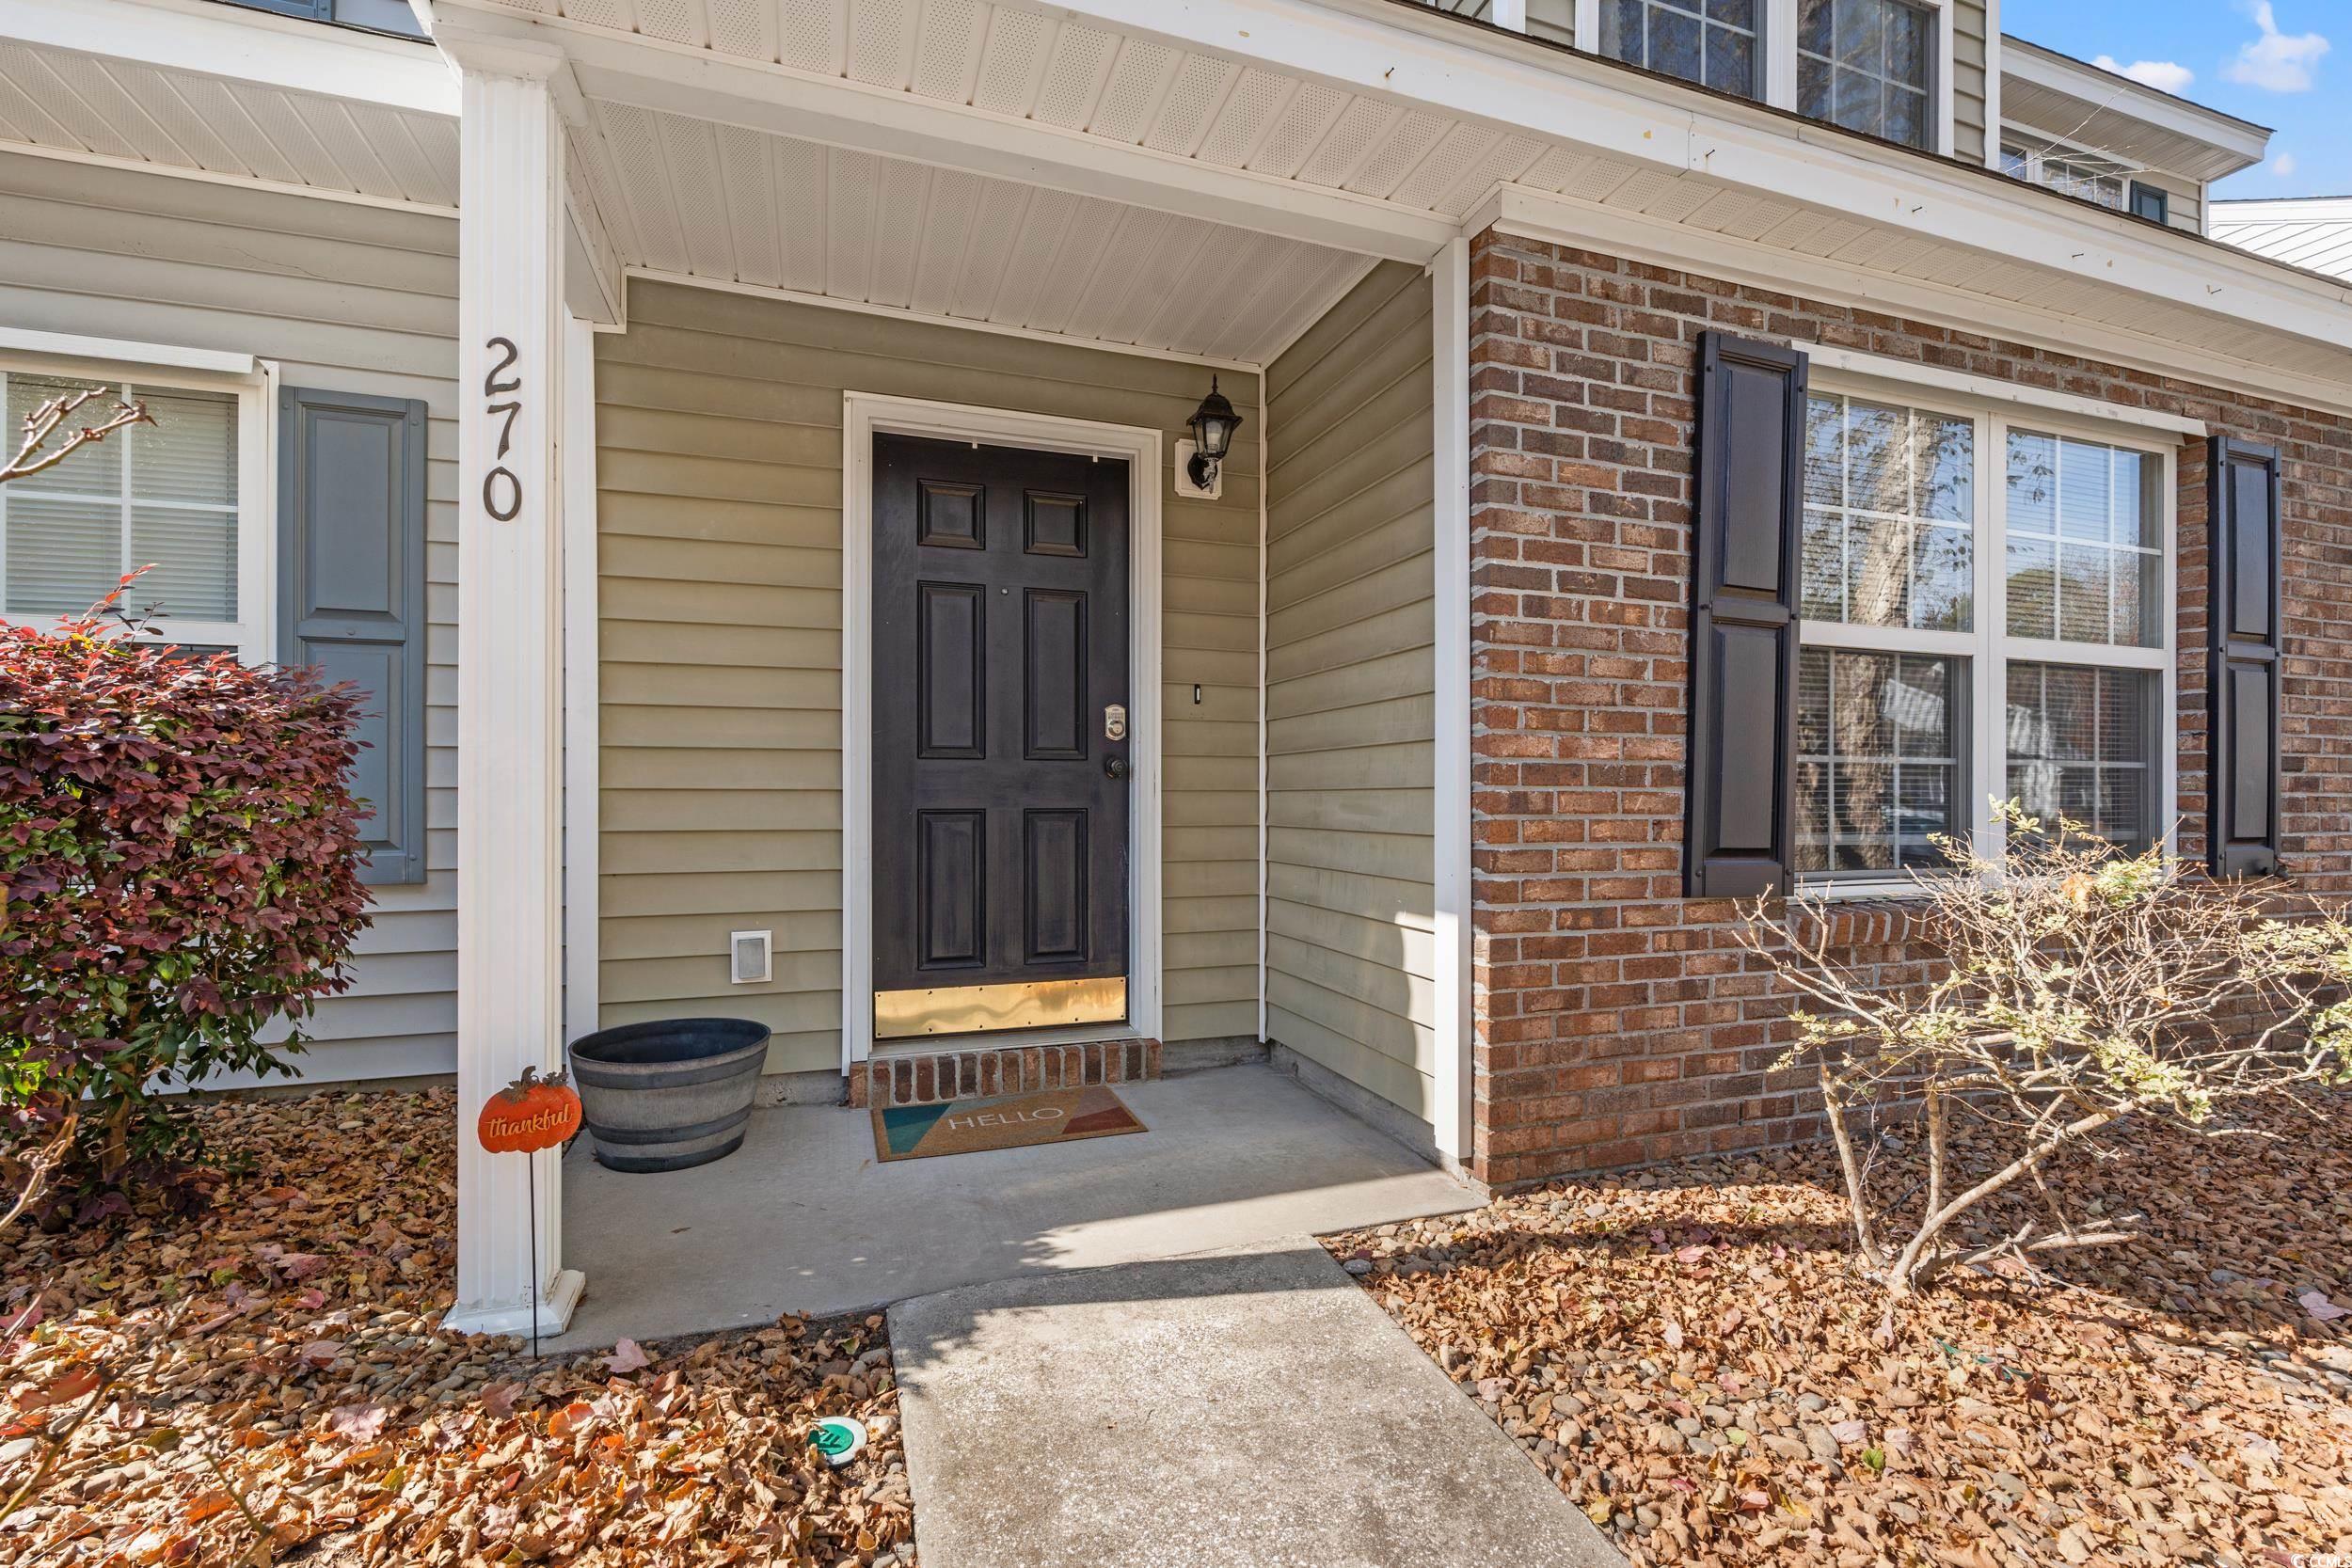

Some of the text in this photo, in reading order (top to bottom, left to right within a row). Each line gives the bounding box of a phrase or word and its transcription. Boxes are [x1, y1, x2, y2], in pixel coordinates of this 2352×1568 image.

[483, 336, 522, 522] 270
[485, 1103, 572, 1138] thankful
[947, 1108, 1064, 1130] HELLO
